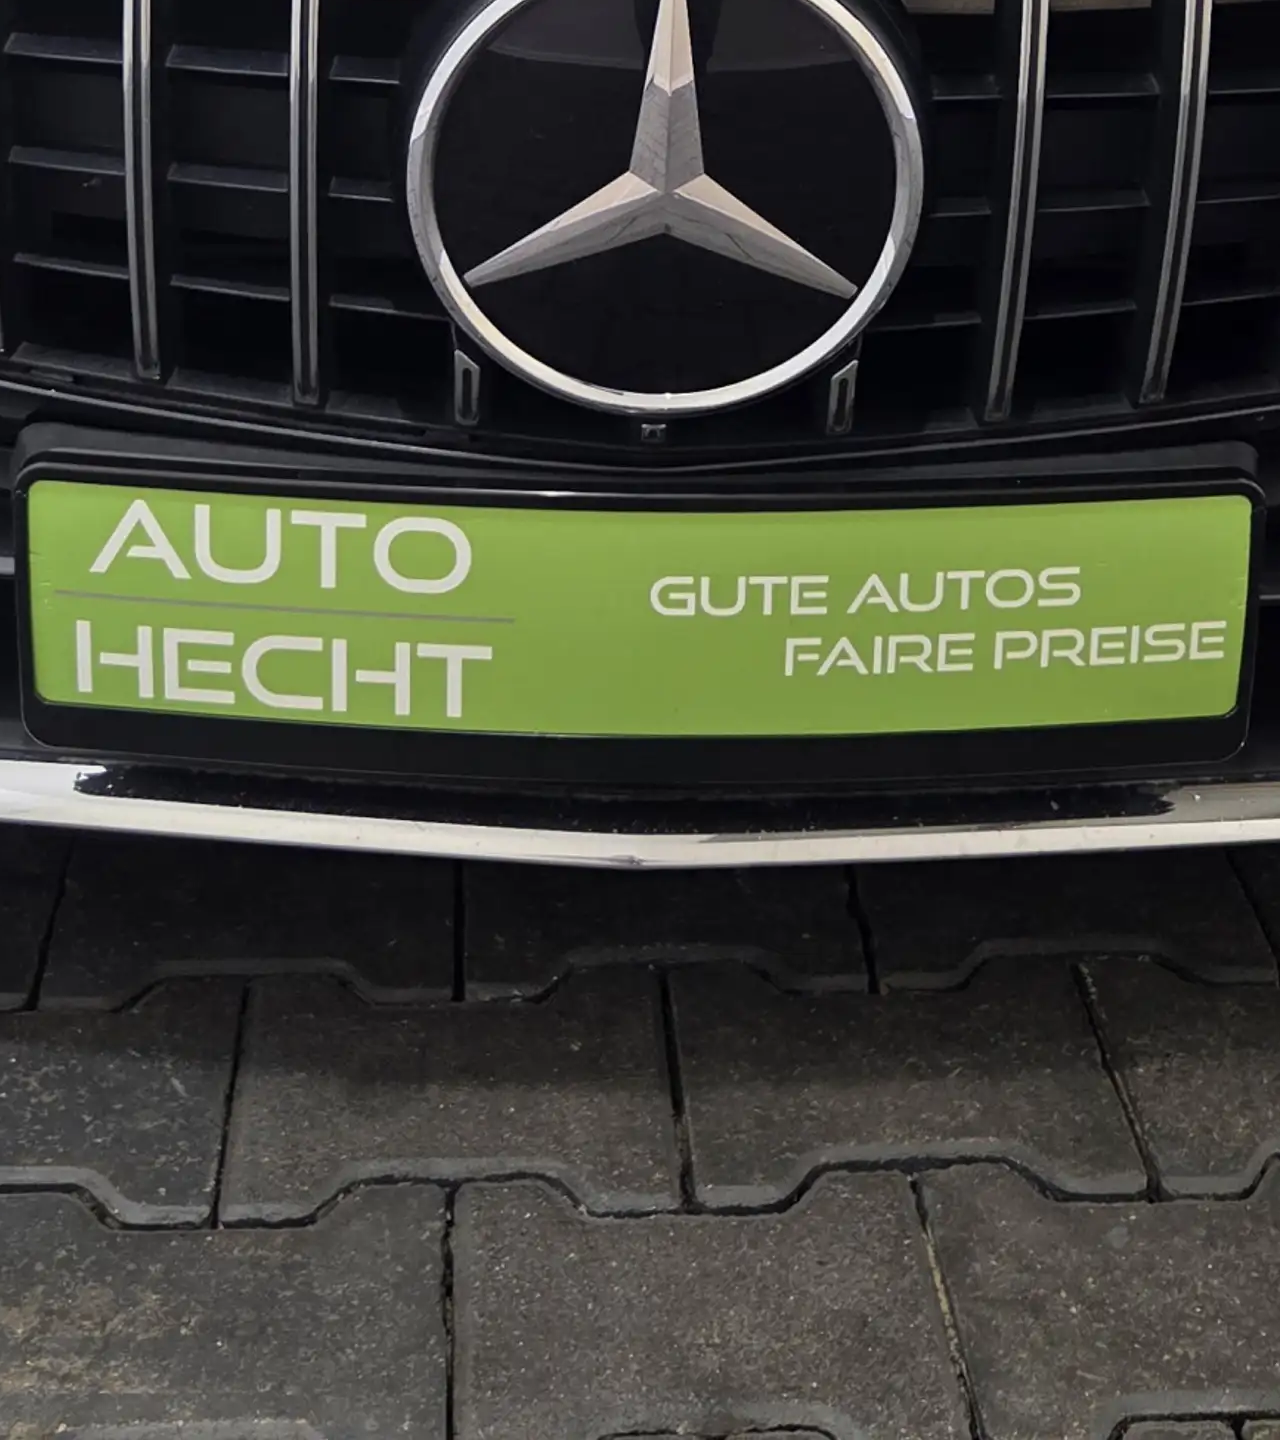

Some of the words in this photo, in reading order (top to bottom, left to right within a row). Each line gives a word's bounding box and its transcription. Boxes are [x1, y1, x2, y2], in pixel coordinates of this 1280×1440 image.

[89, 499, 472, 594] AUTO
[650, 575, 829, 617] GUTE
[847, 566, 1081, 614] AUTOS
[75, 620, 493, 718] HECHT
[784, 633, 976, 677] FAIRE
[993, 620, 1227, 670] PREISE
